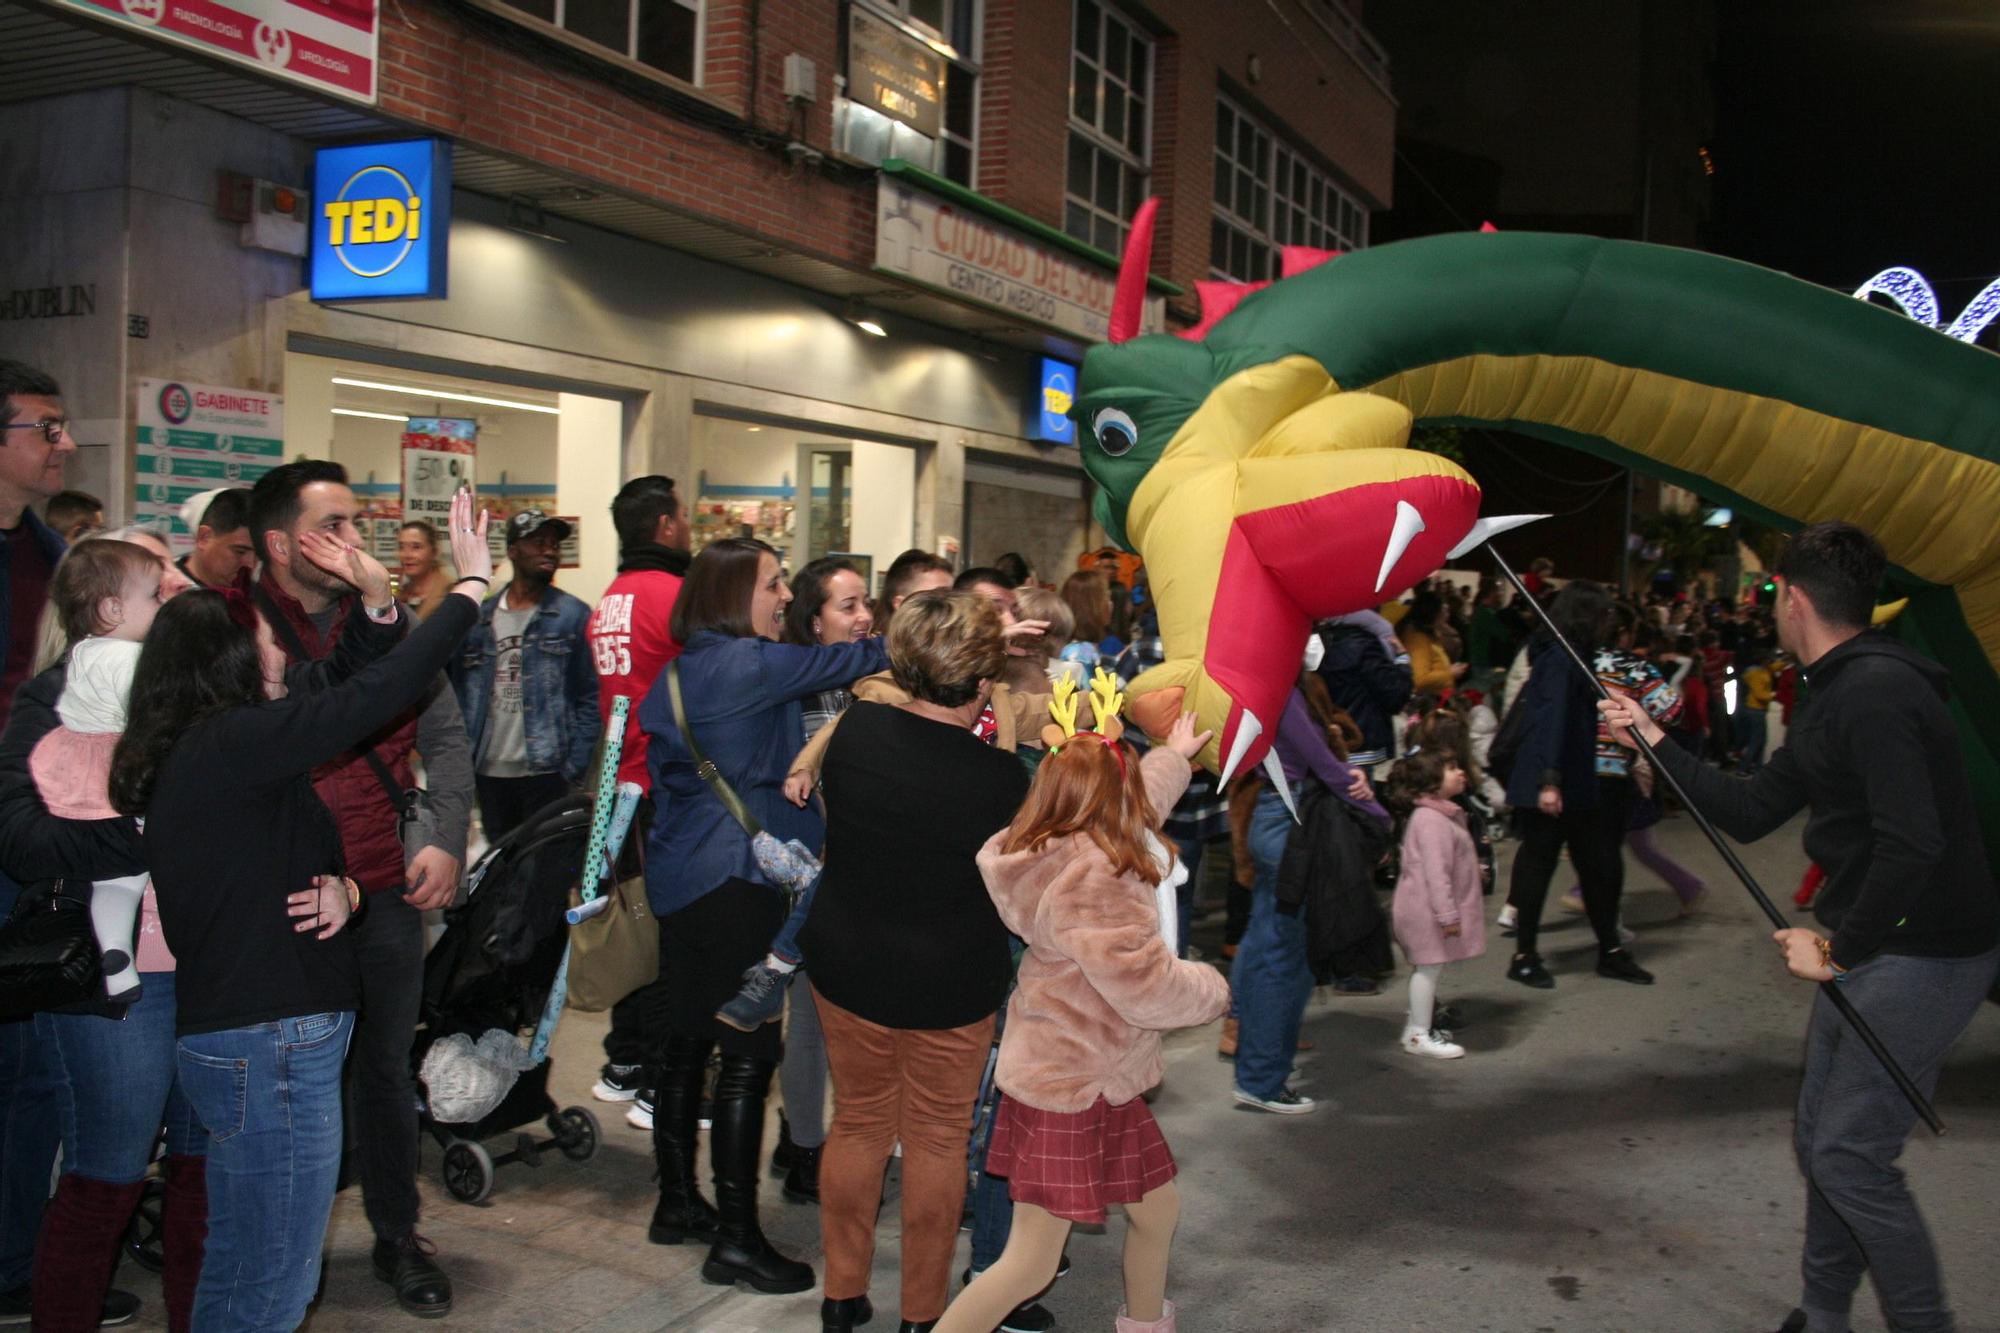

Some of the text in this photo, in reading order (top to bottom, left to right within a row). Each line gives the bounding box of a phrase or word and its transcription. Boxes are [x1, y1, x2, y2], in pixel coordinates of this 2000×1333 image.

[324, 196, 421, 246] TEDi
[933, 205, 1113, 312] CIUDAD DEL SOL
[12, 283, 96, 320] DUBLIN
[947, 262, 1005, 304] CENTRO
[195, 391, 270, 415] GABINETE
